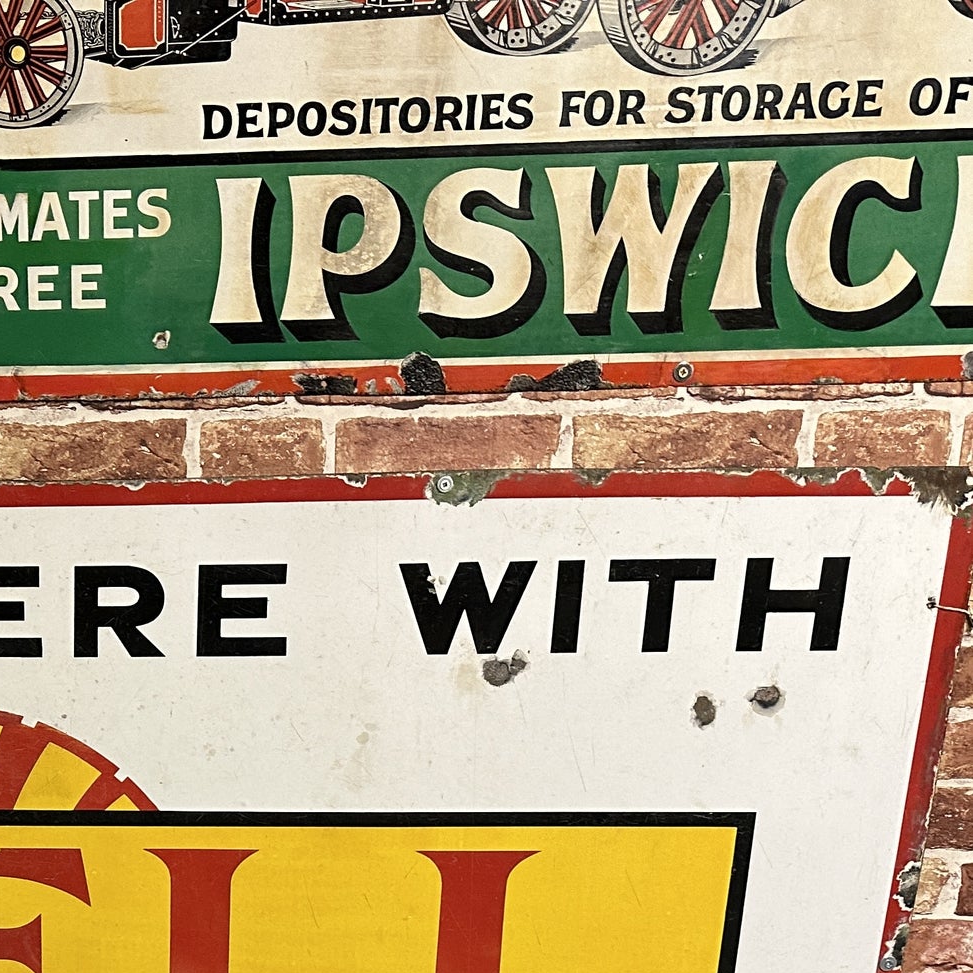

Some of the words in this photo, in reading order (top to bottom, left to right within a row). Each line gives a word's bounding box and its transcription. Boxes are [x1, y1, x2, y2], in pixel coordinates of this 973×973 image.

[202, 90, 534, 141] DEPOSITORIES
[559, 86, 648, 128] FOR
[665, 79, 884, 124] STORAGE
[909, 76, 973, 116] OF
[399, 556, 852, 656] WITH
